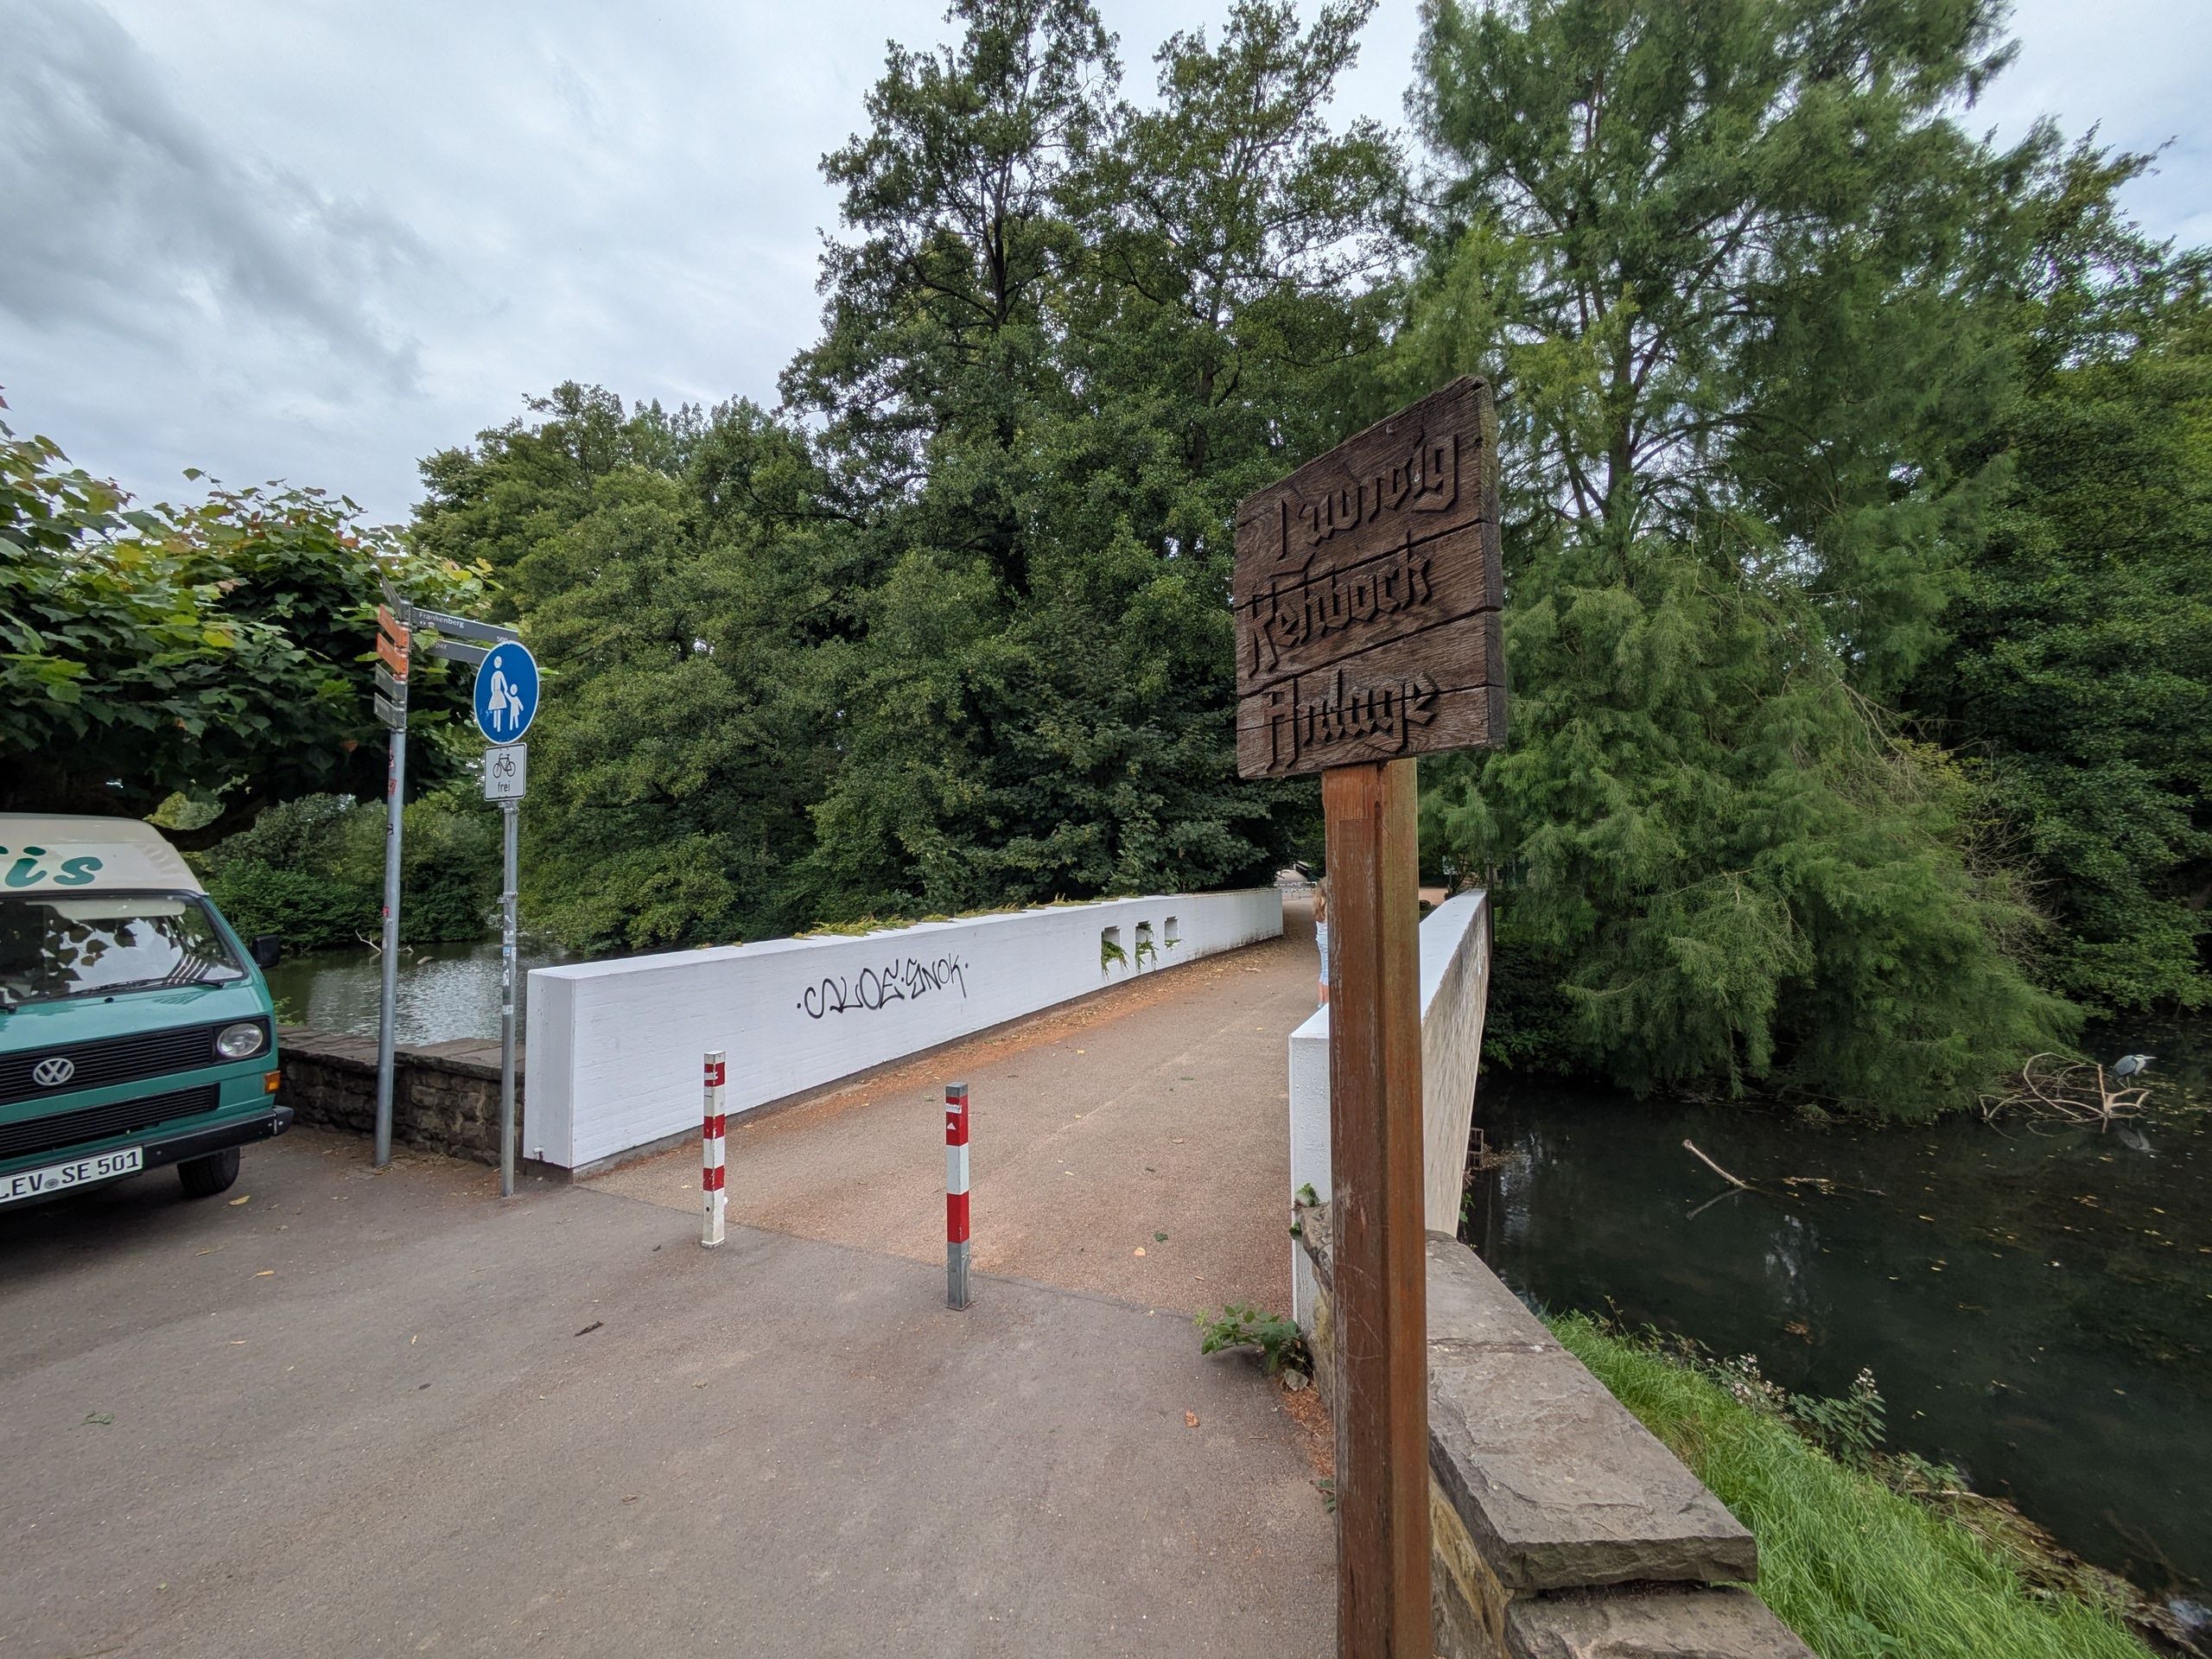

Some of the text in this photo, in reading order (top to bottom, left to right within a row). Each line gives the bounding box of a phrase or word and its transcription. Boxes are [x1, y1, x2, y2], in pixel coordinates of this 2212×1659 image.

[419, 612, 465, 629] Frankenberg
[1249, 529, 1432, 679] Rehbock
[1265, 668, 1440, 772] Anlage
[498, 781, 511, 792] frei
[0, 846, 103, 888] is
[33, 1058, 74, 1085] VW
[62, 1162, 92, 1184] SE
[98, 1151, 139, 1175] 501
